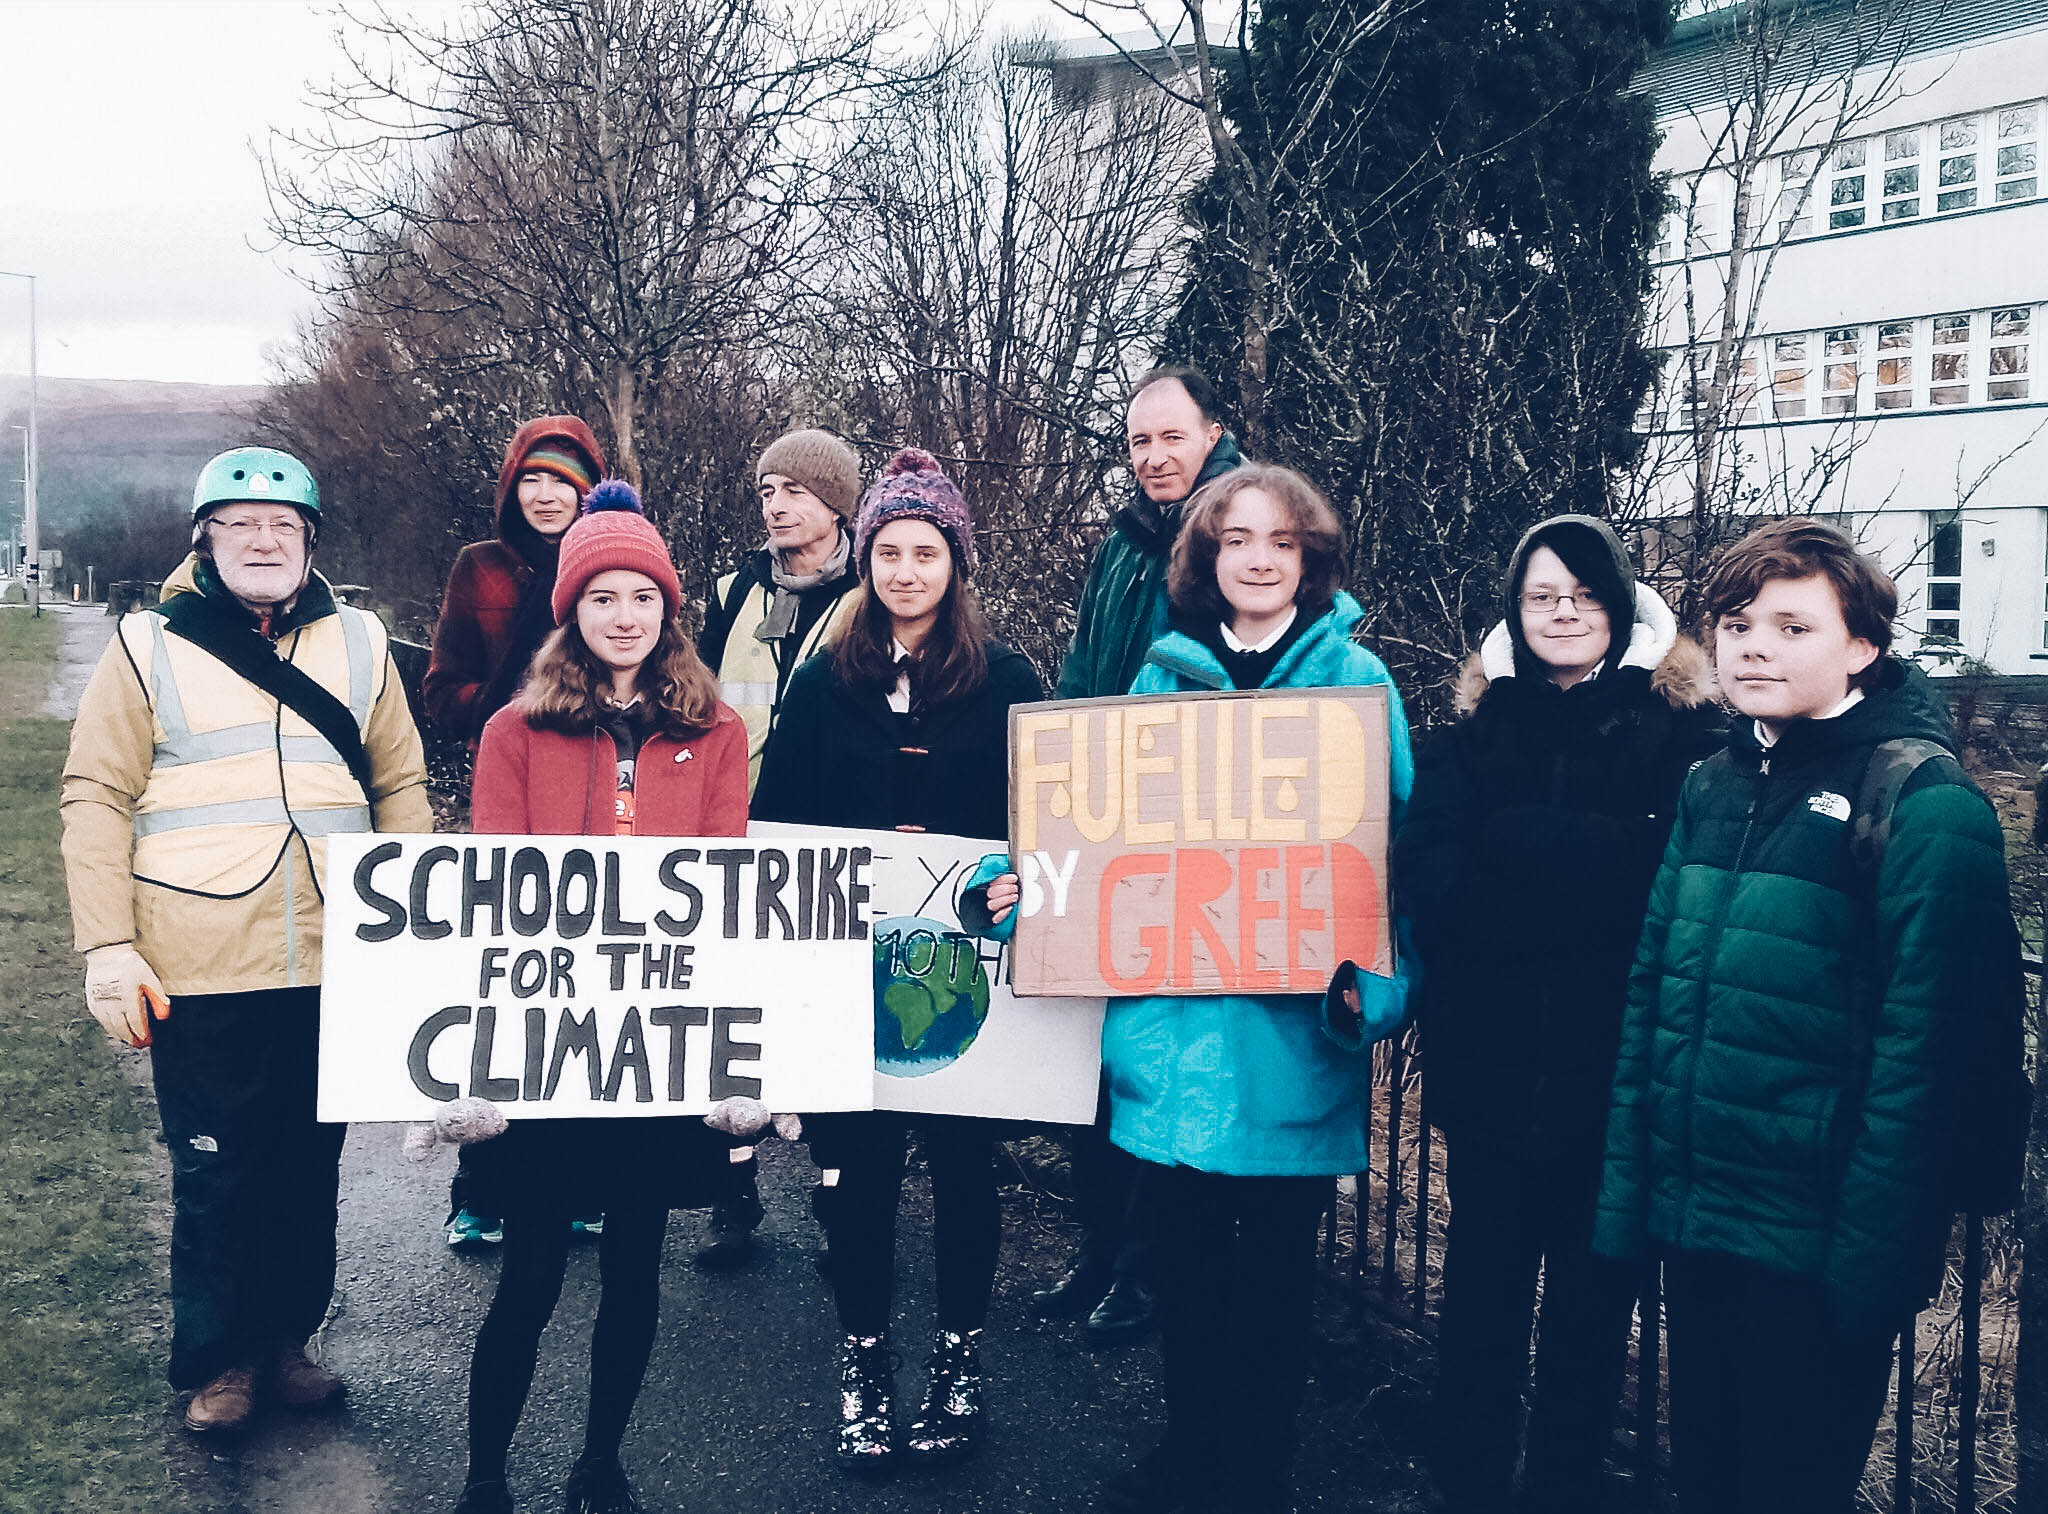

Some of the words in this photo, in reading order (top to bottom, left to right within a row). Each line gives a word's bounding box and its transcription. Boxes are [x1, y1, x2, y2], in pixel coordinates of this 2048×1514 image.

[1017, 700, 1365, 850] FUELLED
[353, 841, 647, 943] SCHOOL
[654, 846, 872, 941] STRIKE
[1021, 850, 1080, 918] BY
[1099, 842, 1379, 993] GREED
[479, 946, 576, 999] FOR
[597, 943, 696, 991] THE
[872, 928, 1010, 987] MOTH
[406, 1005, 763, 1103] CLIMATE
